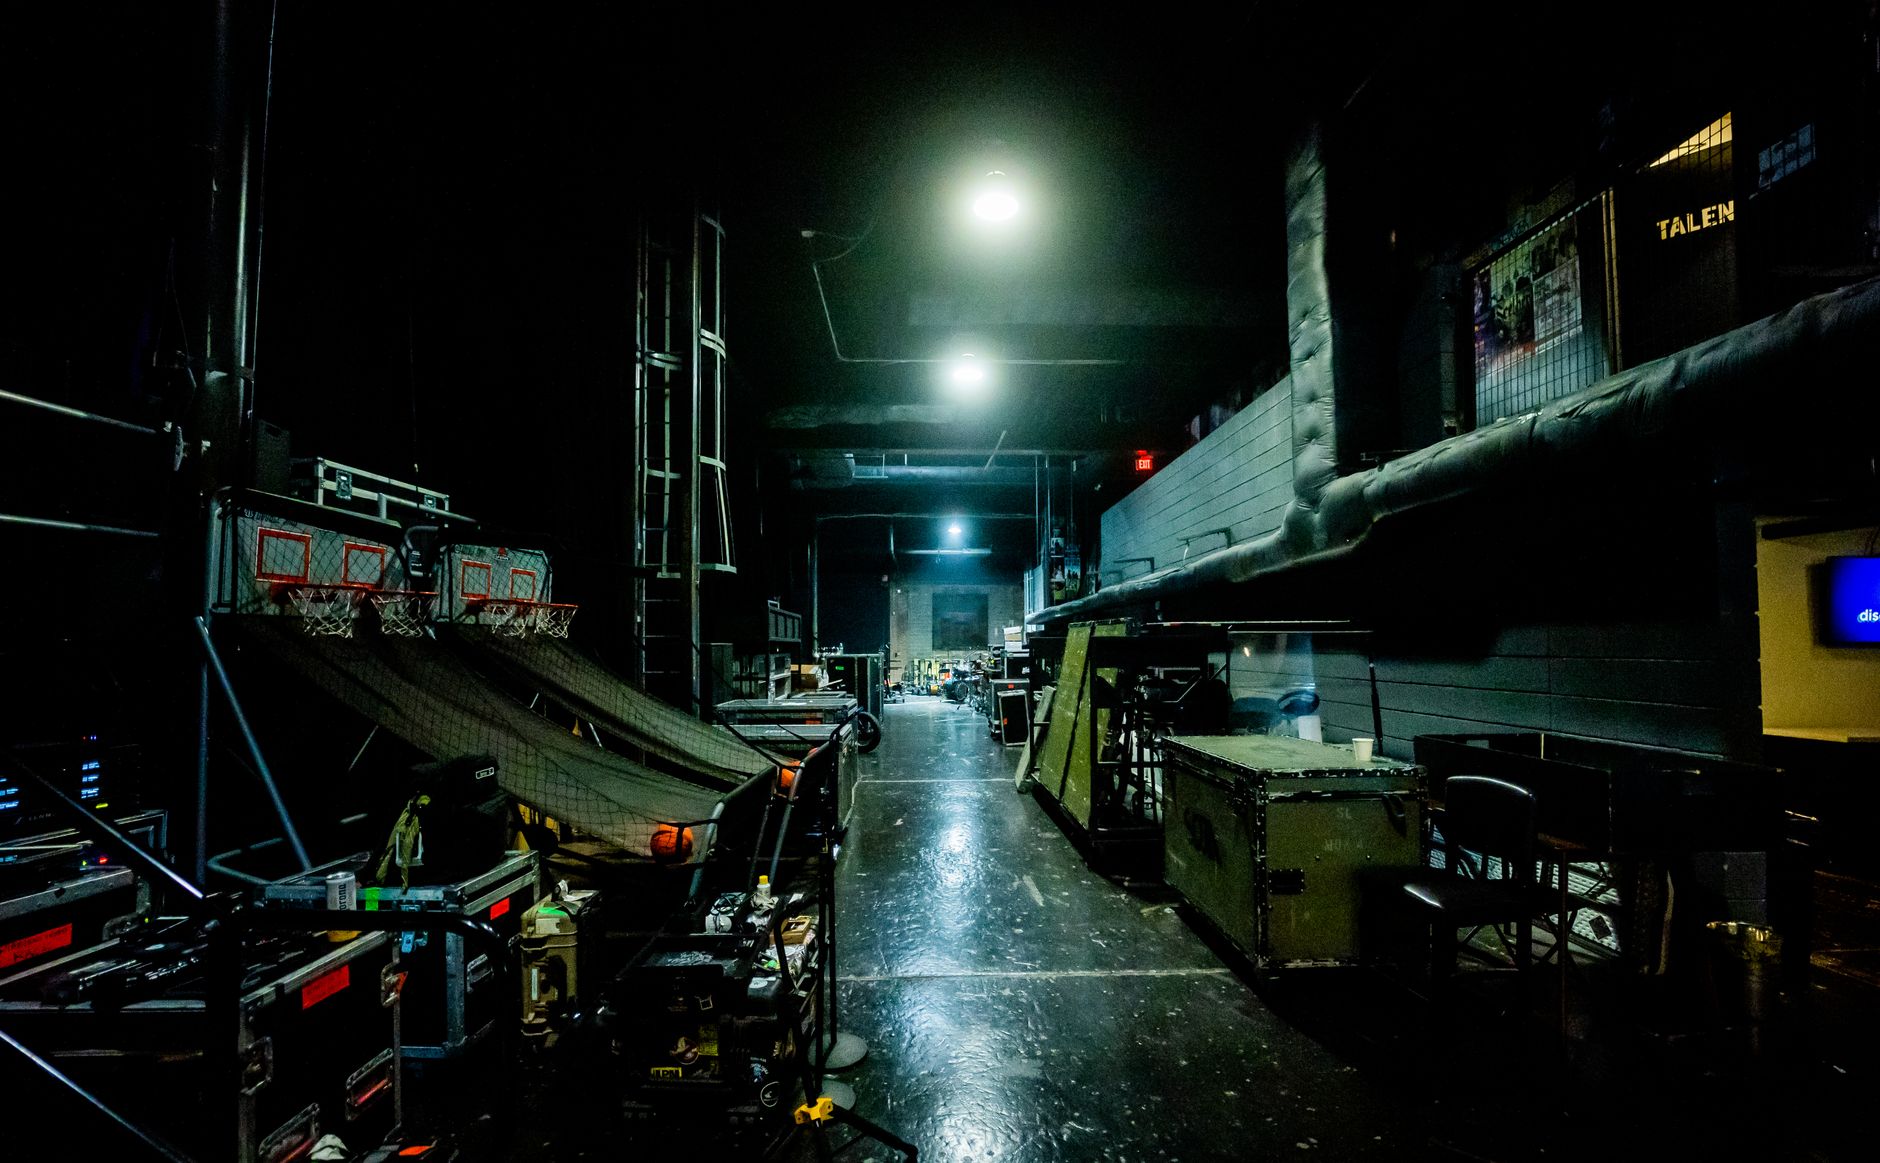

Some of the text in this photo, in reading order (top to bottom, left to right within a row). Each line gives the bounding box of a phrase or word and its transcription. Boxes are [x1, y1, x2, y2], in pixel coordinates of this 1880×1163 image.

[1656, 199, 1735, 241] TALEN
[1138, 459, 1151, 470] EXIT
[1858, 608, 1880, 622] dis
[338, 883, 347, 911] orona
